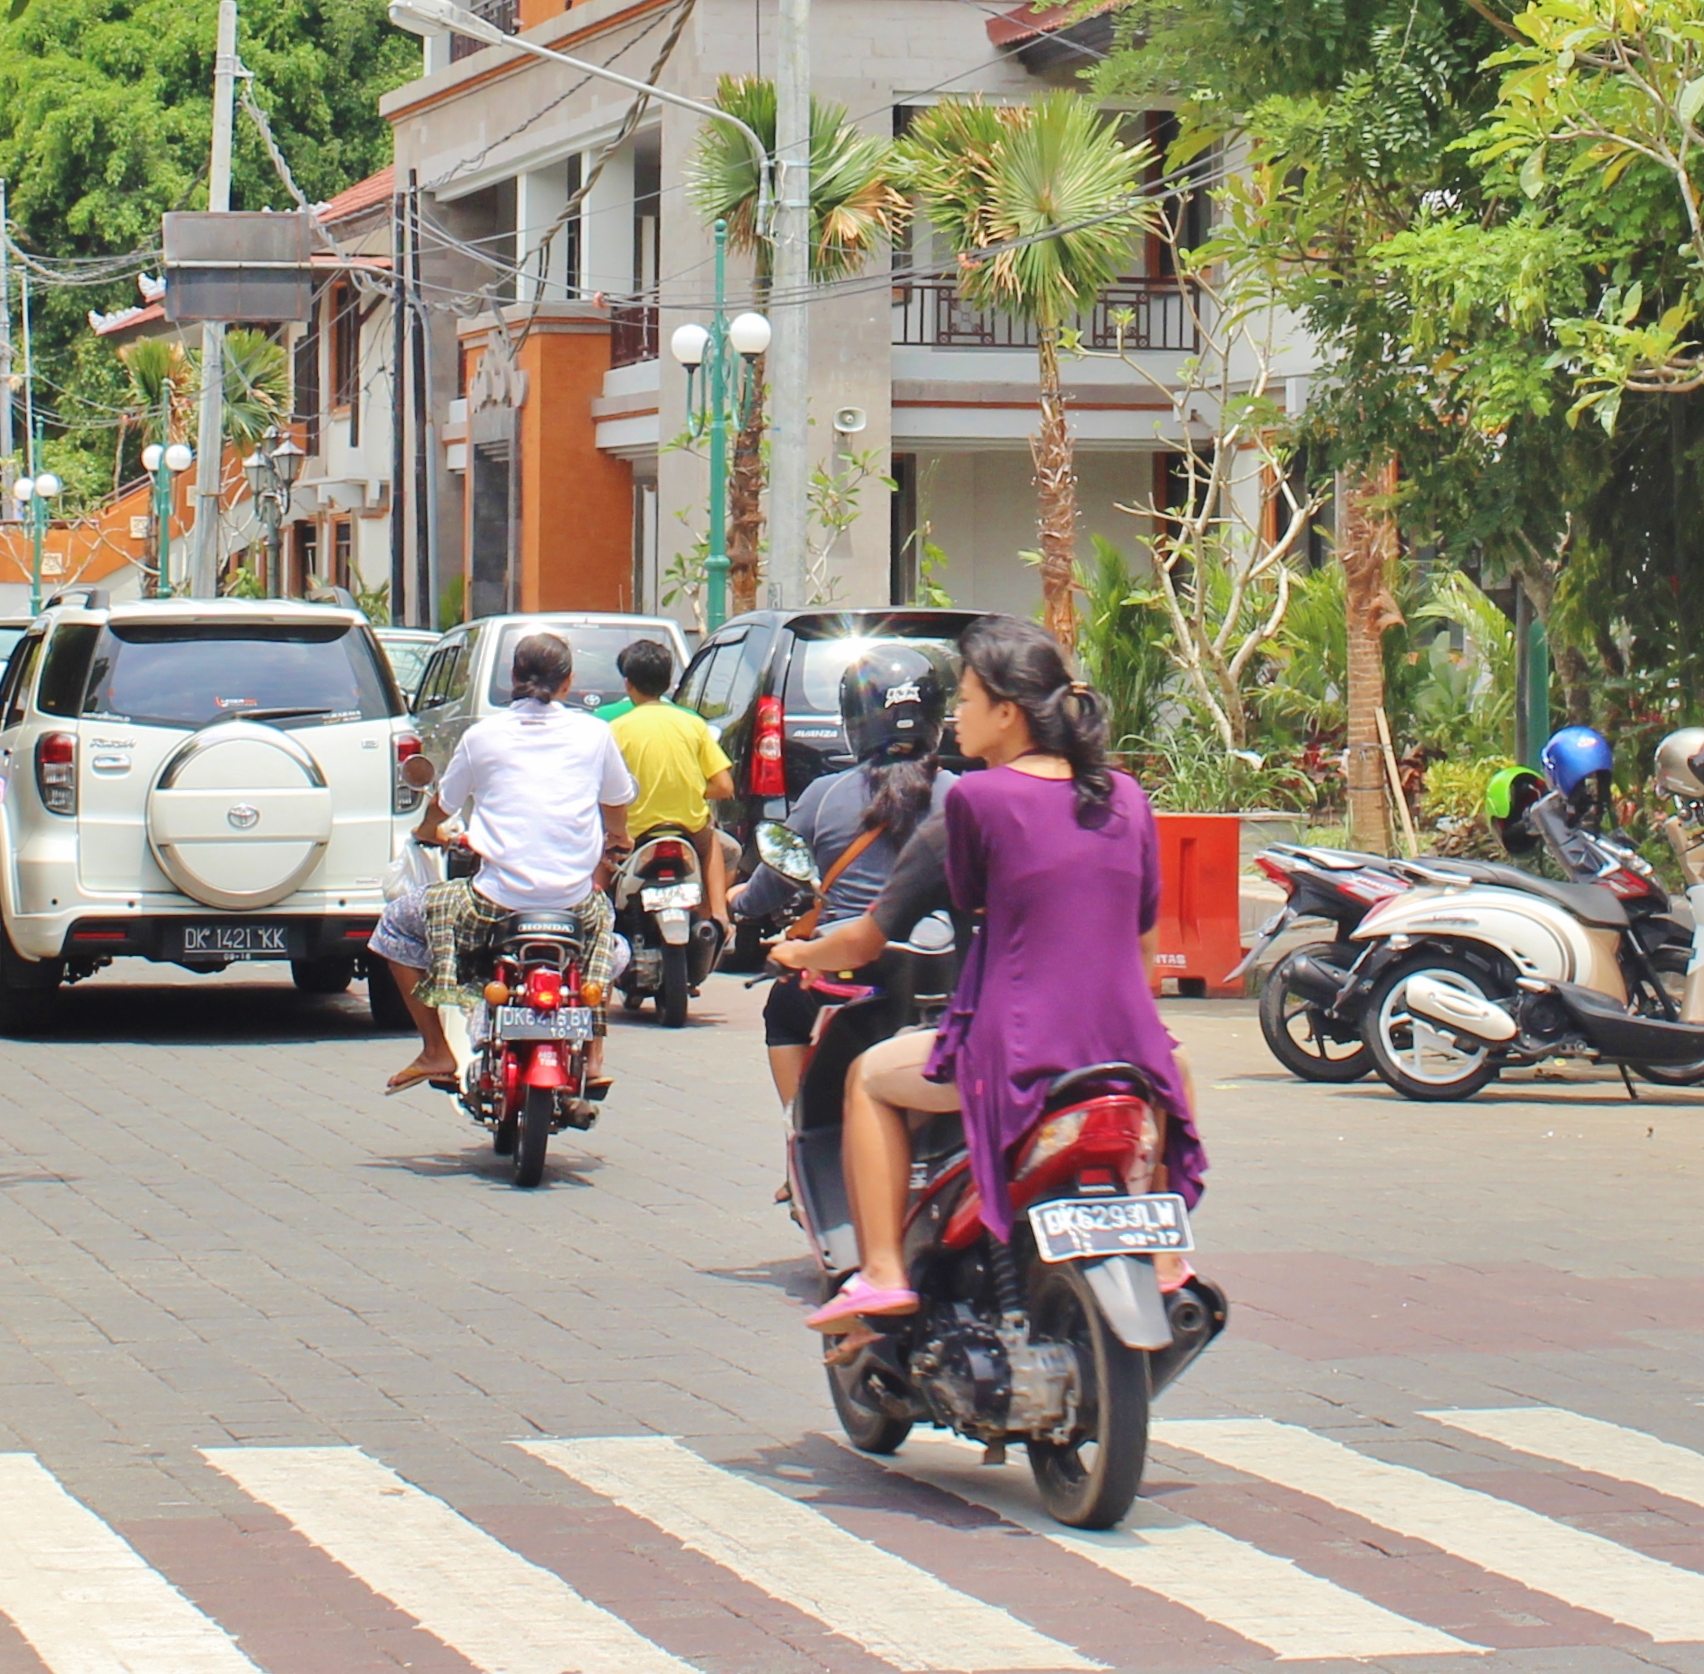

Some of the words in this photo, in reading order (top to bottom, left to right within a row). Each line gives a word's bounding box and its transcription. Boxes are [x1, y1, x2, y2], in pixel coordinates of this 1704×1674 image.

[793, 728, 838, 738] AVANZA
[521, 923, 572, 933] HONDA
[185, 927, 208, 949] DK
[216, 927, 252, 949] 1421
[260, 927, 286, 949] KK
